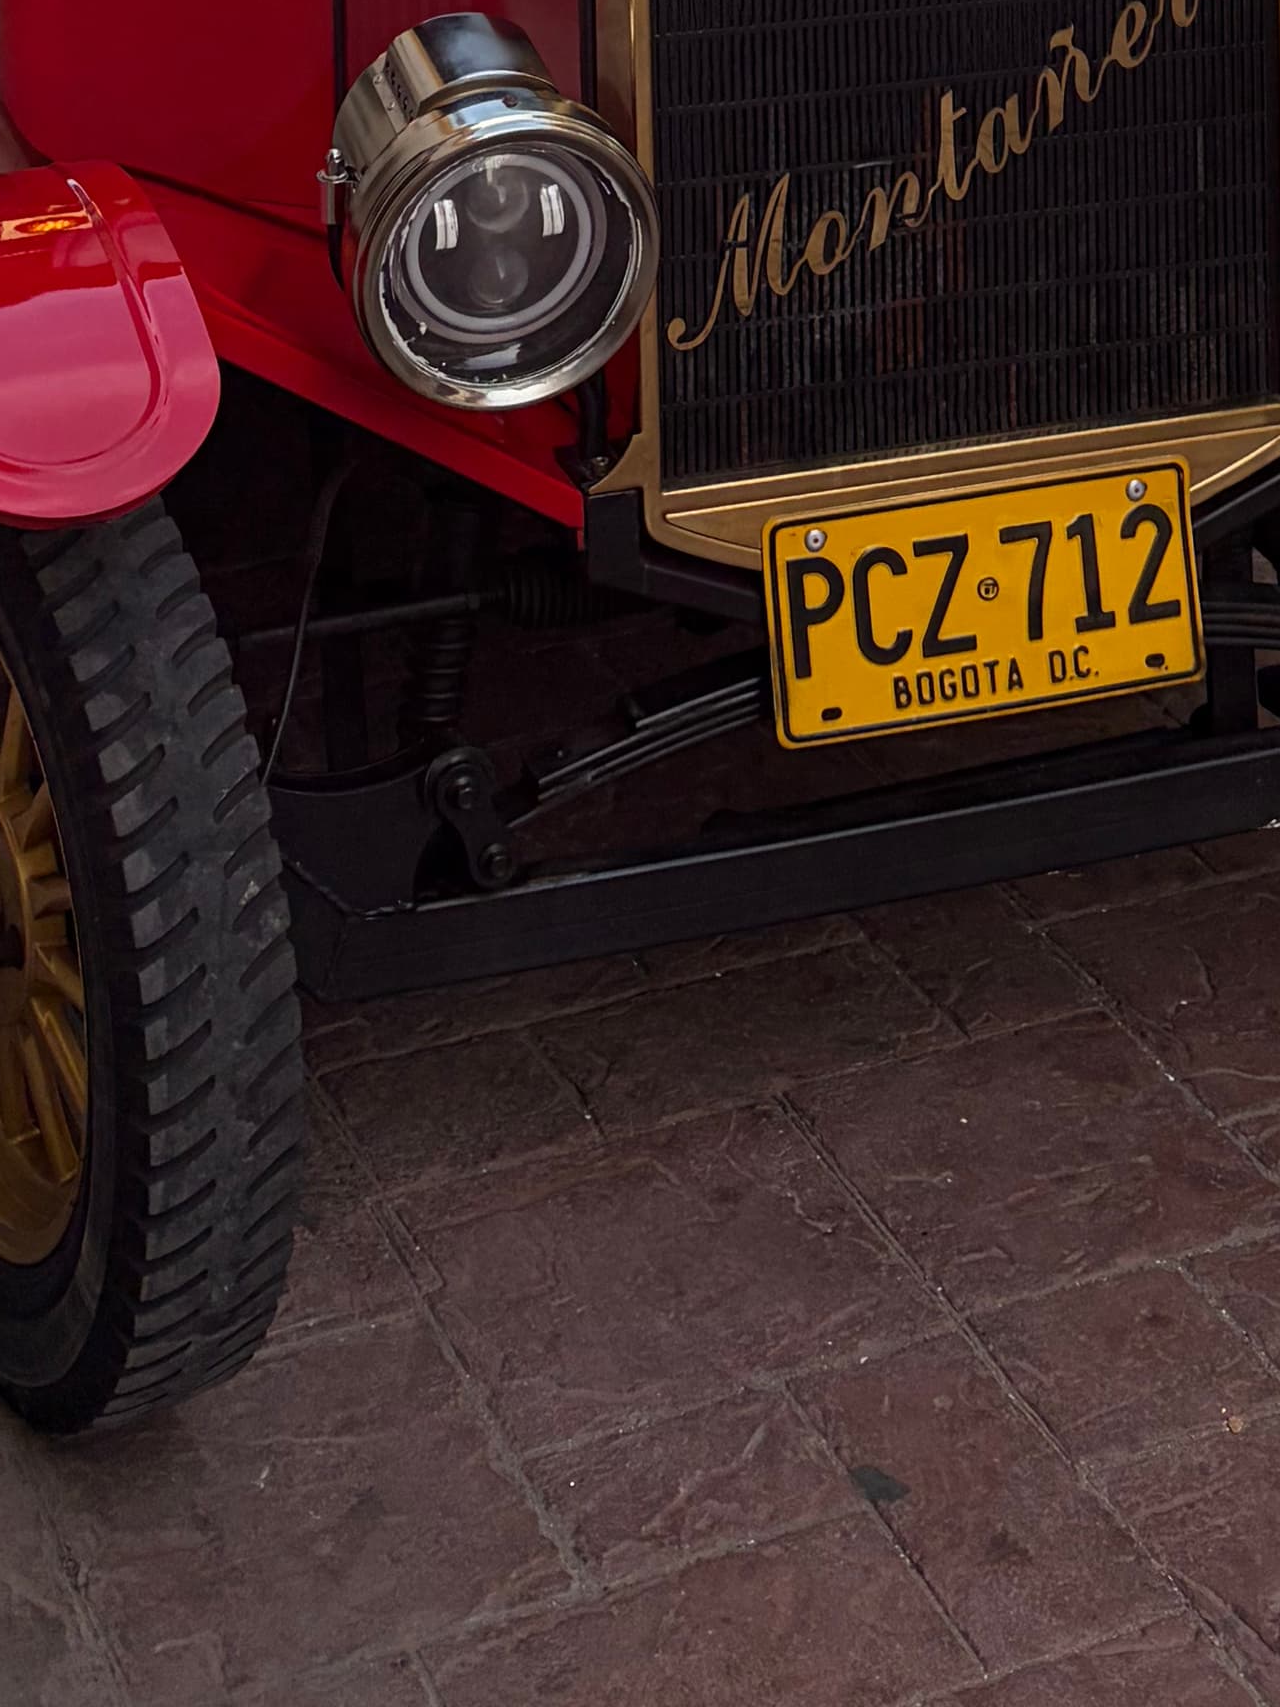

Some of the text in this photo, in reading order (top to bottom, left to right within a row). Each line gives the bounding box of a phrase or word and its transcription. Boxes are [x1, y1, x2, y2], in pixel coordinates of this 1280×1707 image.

[786, 503, 1182, 679] PCZ 712
[893, 657, 1025, 710] BOGOTA
